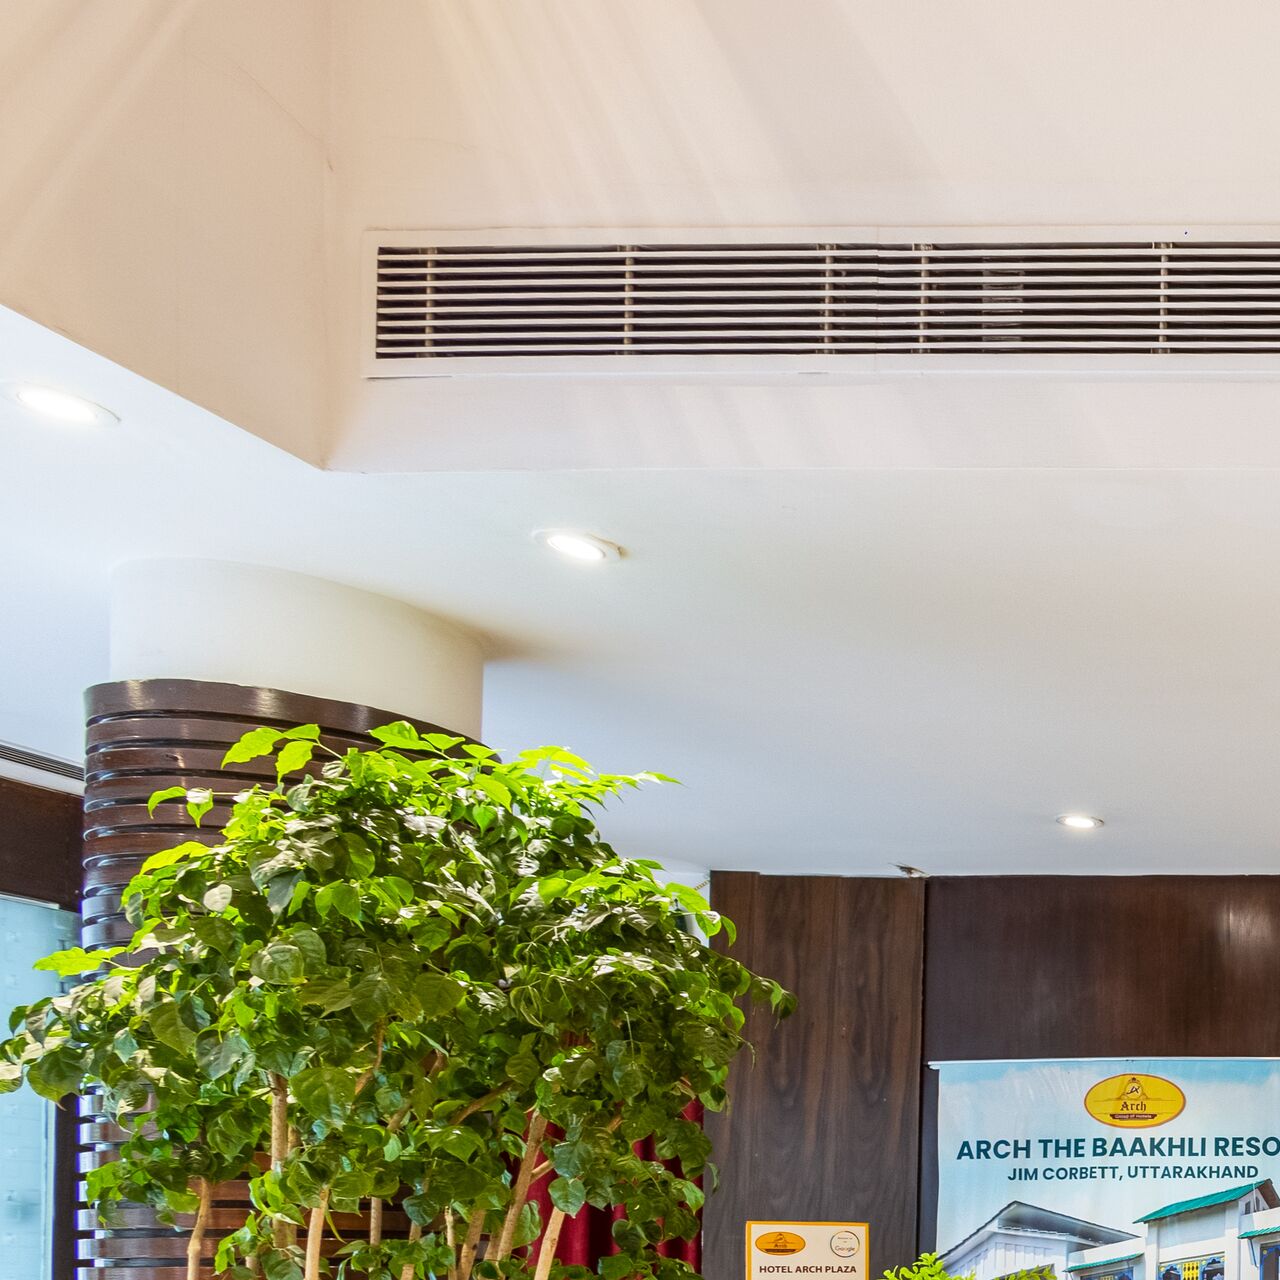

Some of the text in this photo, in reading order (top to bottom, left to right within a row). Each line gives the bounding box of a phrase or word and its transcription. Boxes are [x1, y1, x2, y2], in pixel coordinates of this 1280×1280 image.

[1120, 1101, 1146, 1112] Arch
[957, 1139, 1030, 1160] ARCH
[1038, 1138, 1085, 1158] THE
[1092, 1137, 1206, 1157] BAAKHLI
[1007, 1165, 1258, 1182] JIM CORBETT, UTTARAKHAND
